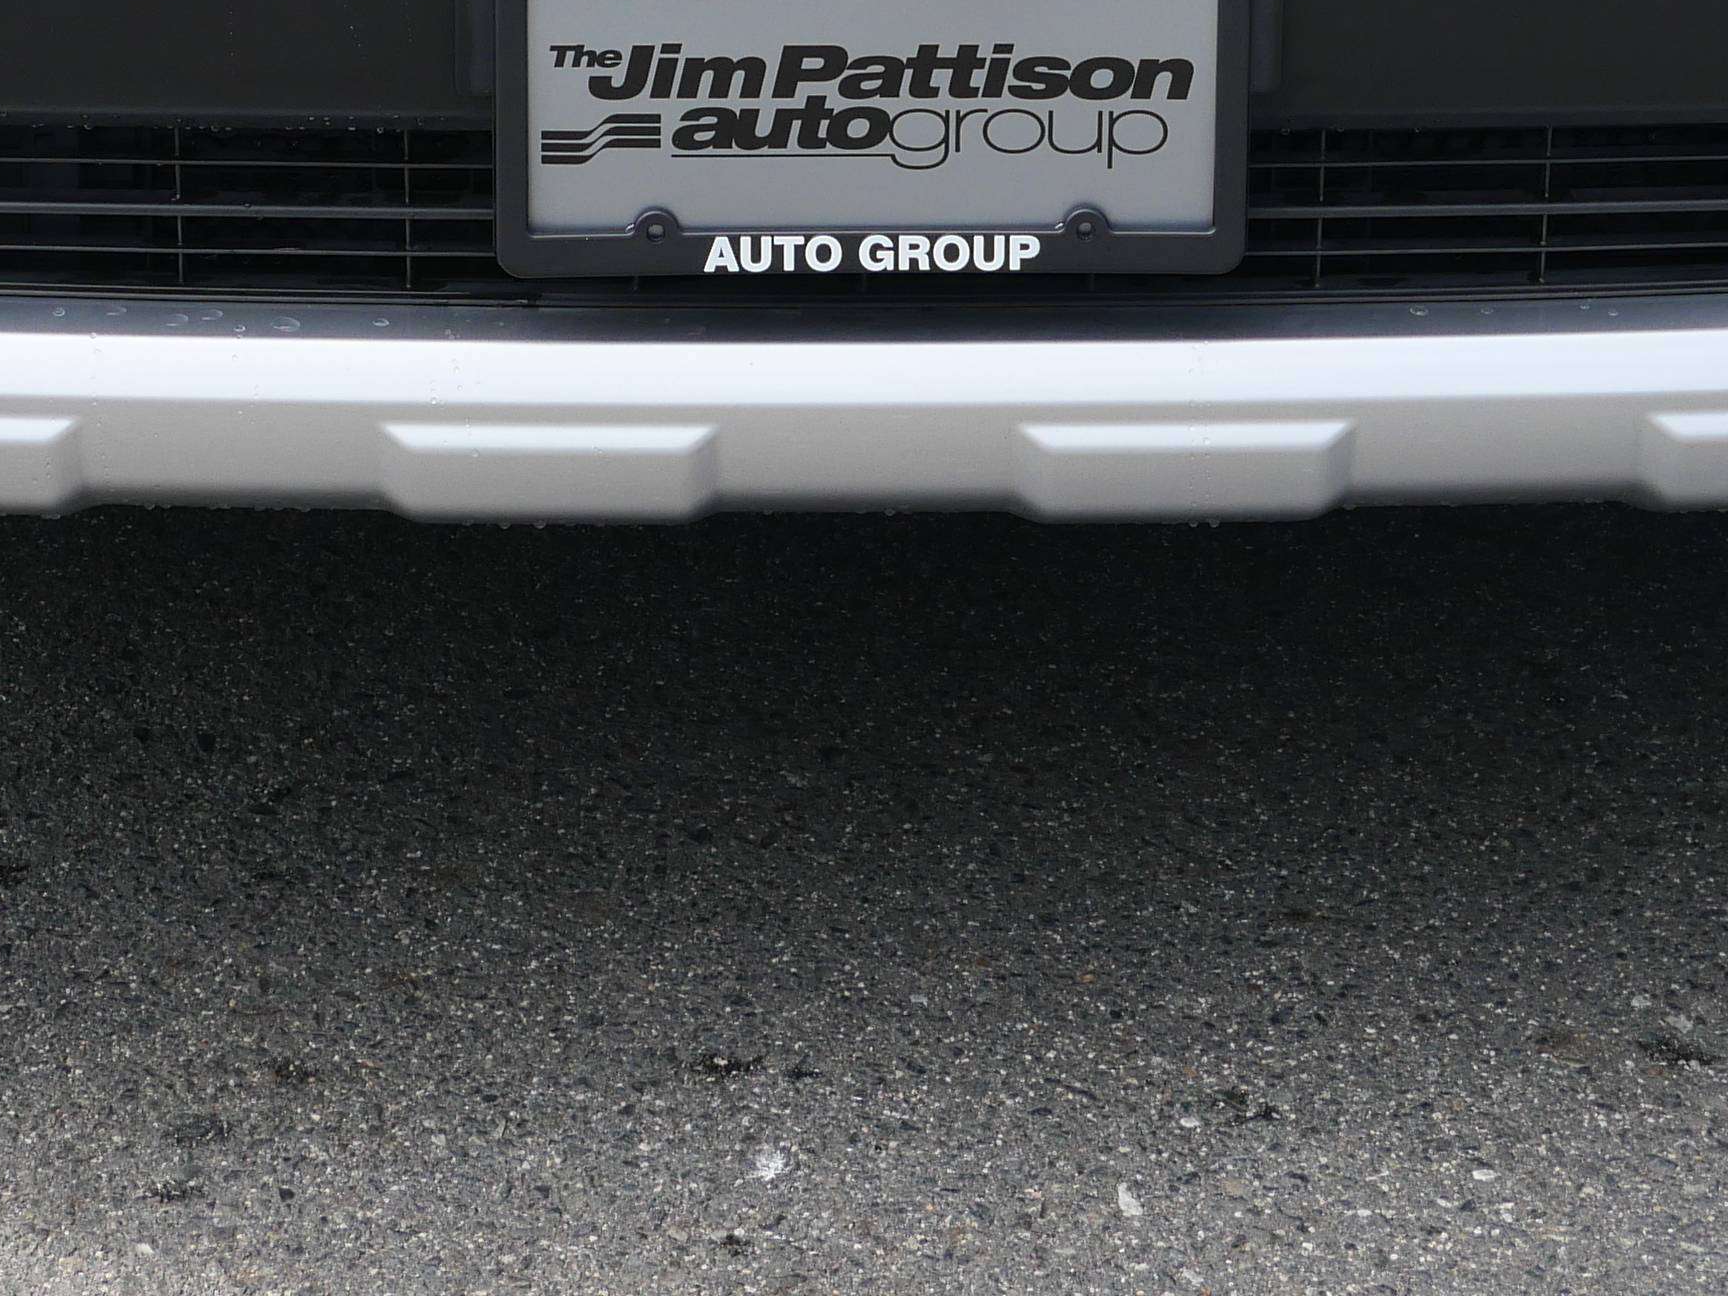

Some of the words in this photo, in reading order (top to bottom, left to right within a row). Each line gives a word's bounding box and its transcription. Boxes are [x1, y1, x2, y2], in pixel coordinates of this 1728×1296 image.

[549, 43, 623, 69] The
[587, 42, 768, 101] Jim
[771, 42, 1195, 101] Pattison
[703, 235, 842, 272] AUTO
[858, 234, 1041, 273] GROUP
